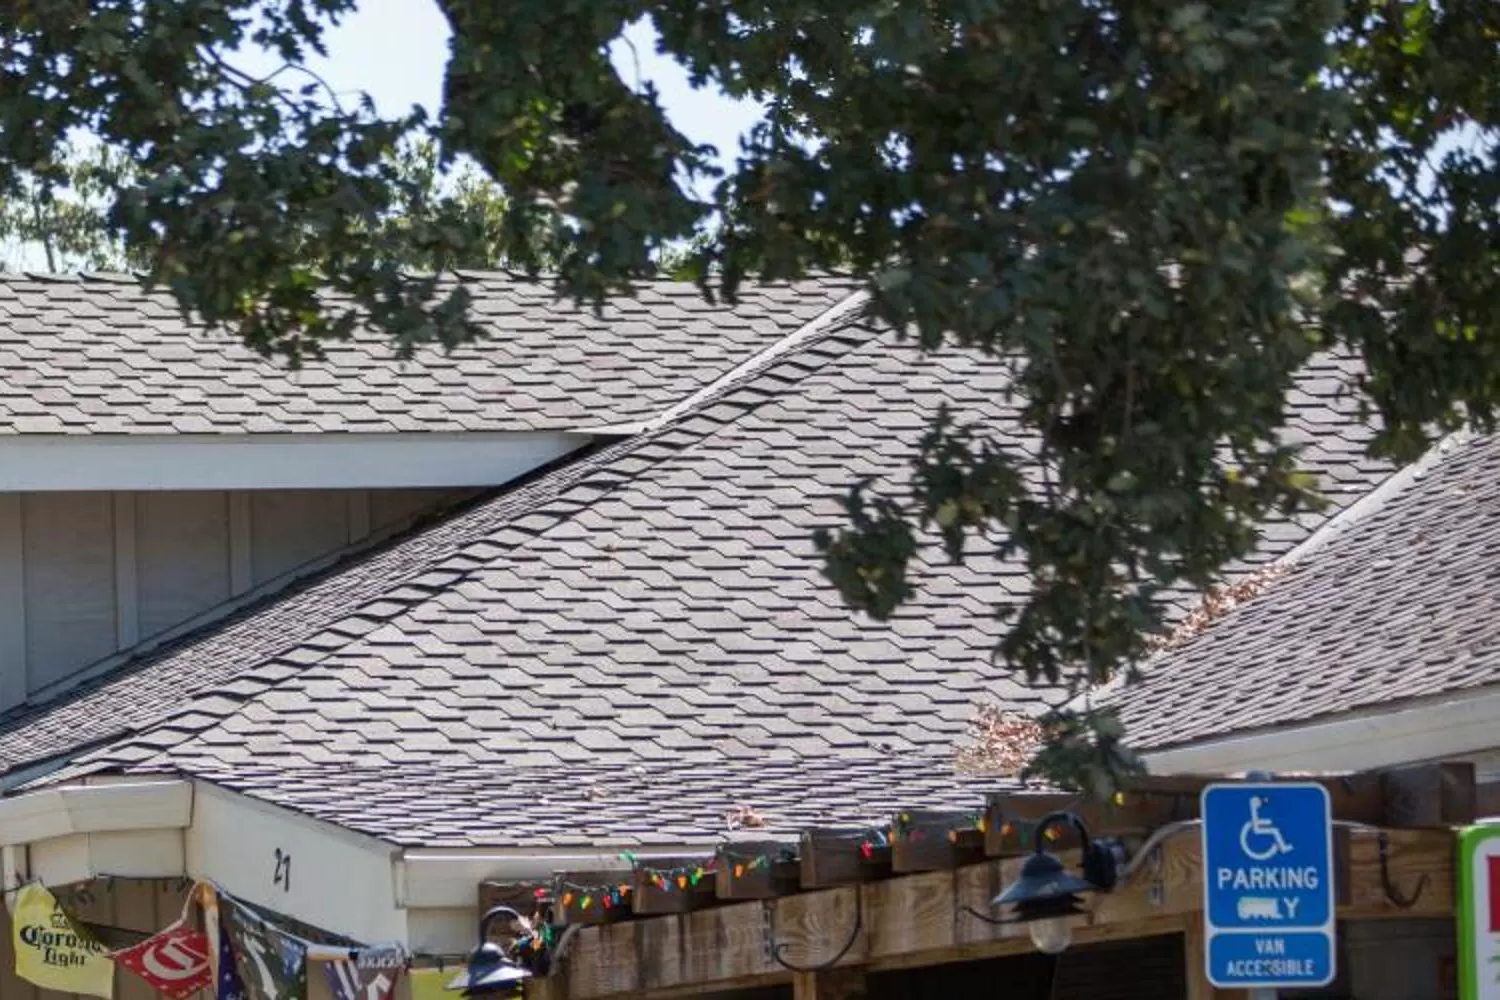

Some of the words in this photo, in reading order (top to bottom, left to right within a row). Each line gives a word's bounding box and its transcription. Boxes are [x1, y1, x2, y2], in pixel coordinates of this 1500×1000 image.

[1217, 866, 1319, 890] PARKING
[1255, 938, 1285, 955] VAN
[1226, 959, 1315, 977] ACCESSIBLE
